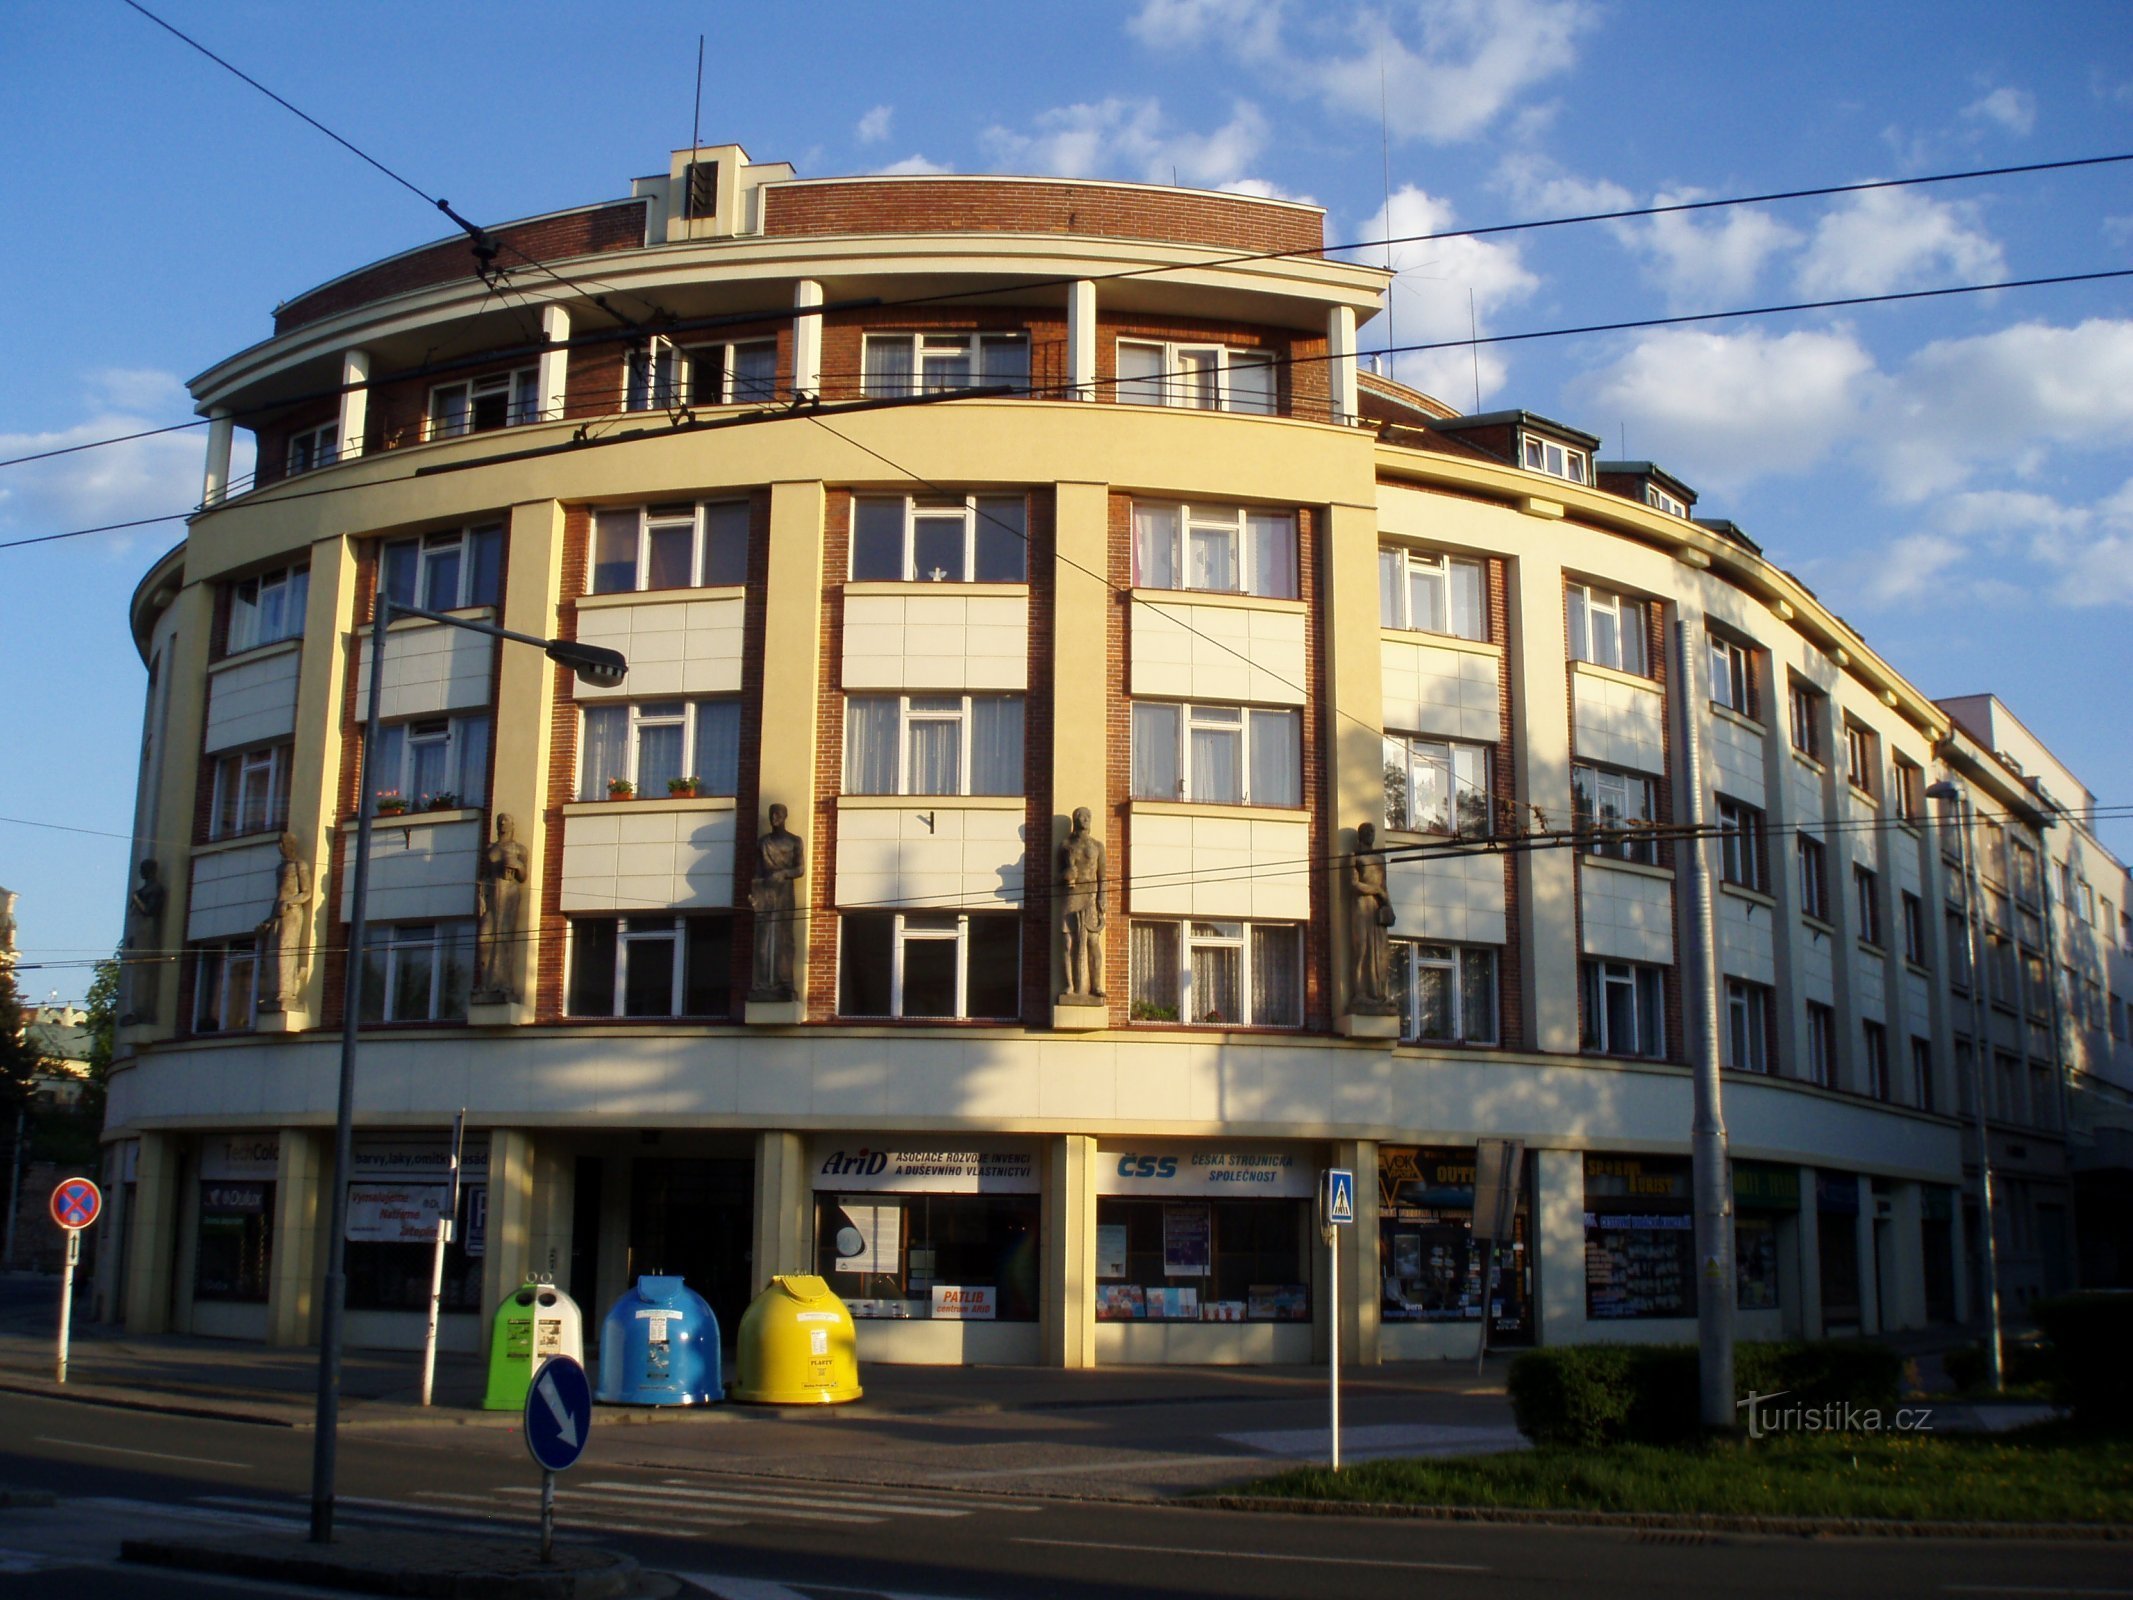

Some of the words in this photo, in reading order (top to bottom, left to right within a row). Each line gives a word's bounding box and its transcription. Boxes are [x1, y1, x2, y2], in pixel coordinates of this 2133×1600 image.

[896, 1152, 942, 1162] ASOCIACE
[946, 1152, 986, 1163] ROZVOJE
[895, 1165, 902, 1175] A
[905, 1164, 961, 1176] DUŠEVNÍHO
[966, 1164, 1030, 1177] VLASTNICTVÍ
[1117, 1152, 1178, 1178] ČSS
[1209, 1168, 1277, 1182] SPOLEČNOST
[943, 1290, 985, 1304] PATLIB
